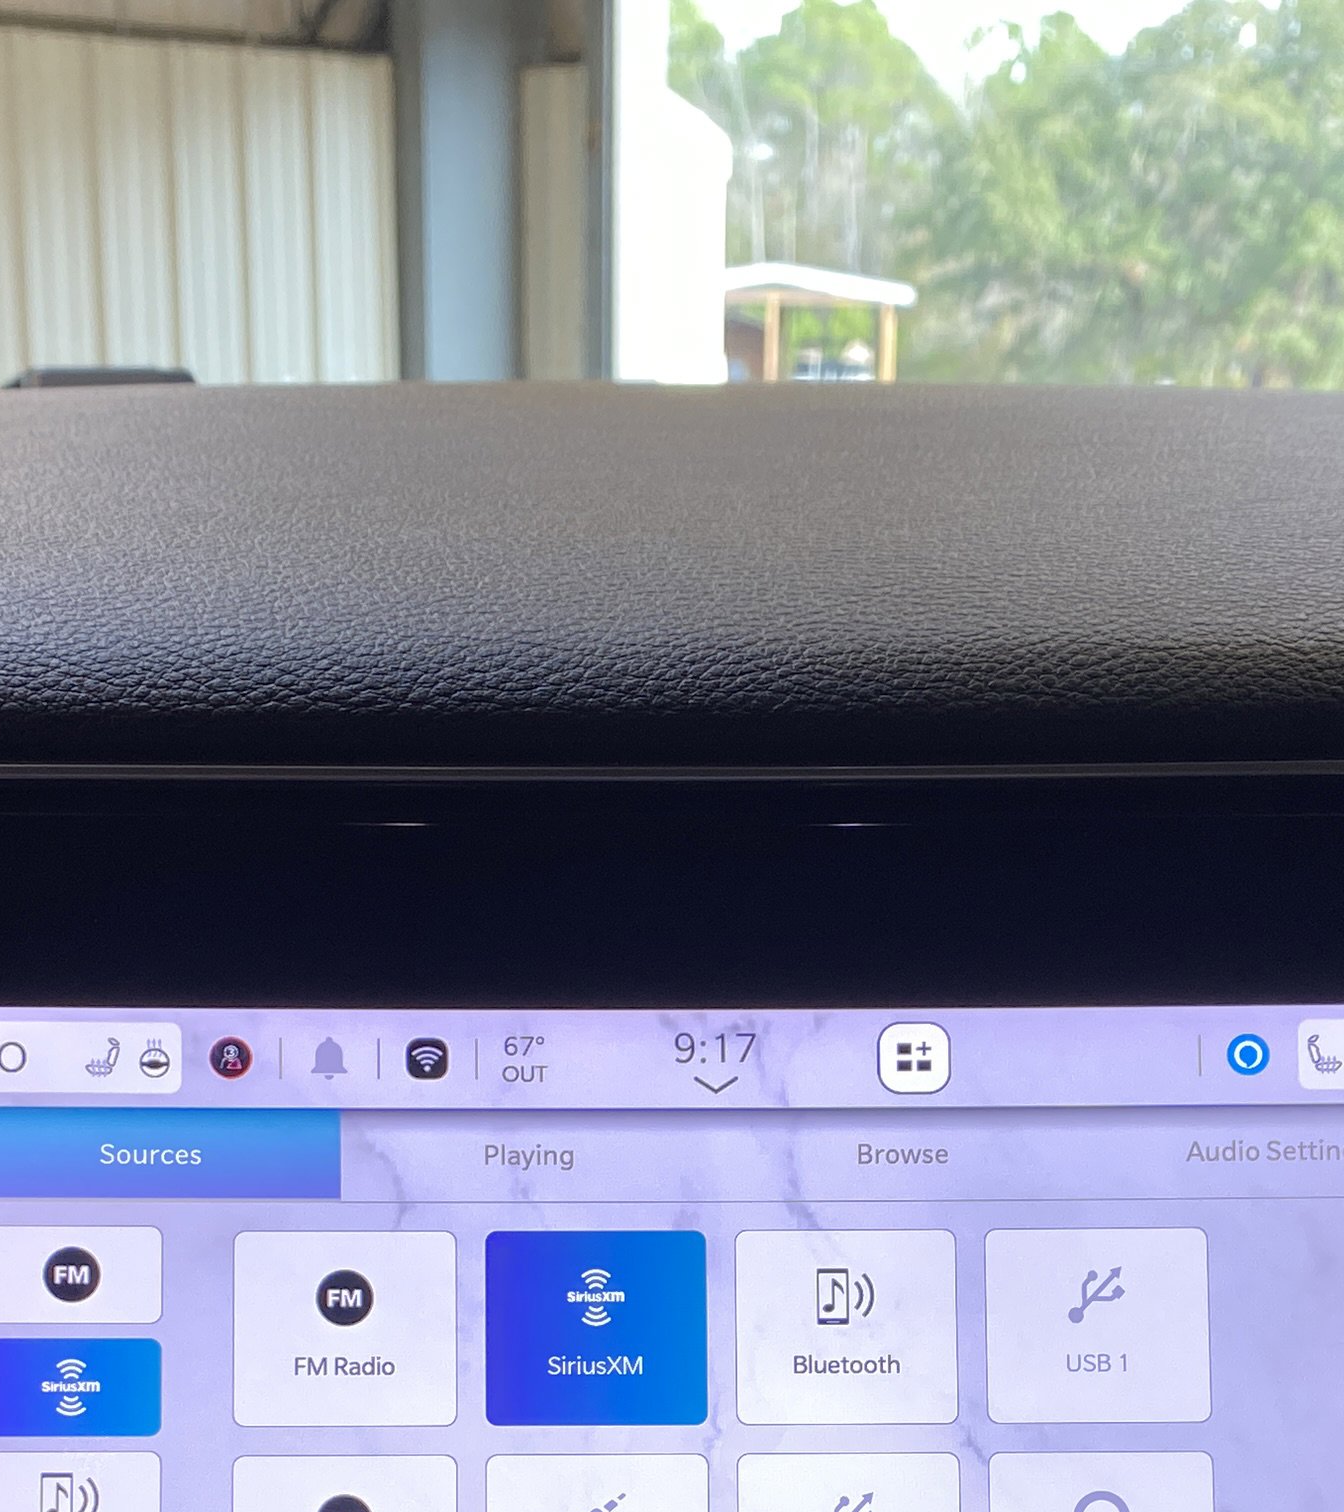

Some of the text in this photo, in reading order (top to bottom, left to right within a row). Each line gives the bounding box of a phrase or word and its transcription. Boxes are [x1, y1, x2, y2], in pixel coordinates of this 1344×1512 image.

[504, 1036, 545, 1057] 67°
[674, 1032, 757, 1064] 9:17
[501, 1065, 548, 1083] OUT
[99, 1143, 202, 1165] Sources
[484, 1143, 574, 1171] Playing
[857, 1143, 949, 1165] Browse
[1185, 1139, 1260, 1162] Audio
[53, 1265, 90, 1285] FM
[326, 1288, 363, 1308] FM
[294, 1356, 396, 1376] FM Radio
[547, 1355, 643, 1375] SiriusXM
[793, 1354, 901, 1374] Bluetooth
[1066, 1353, 1127, 1373] USB 1
